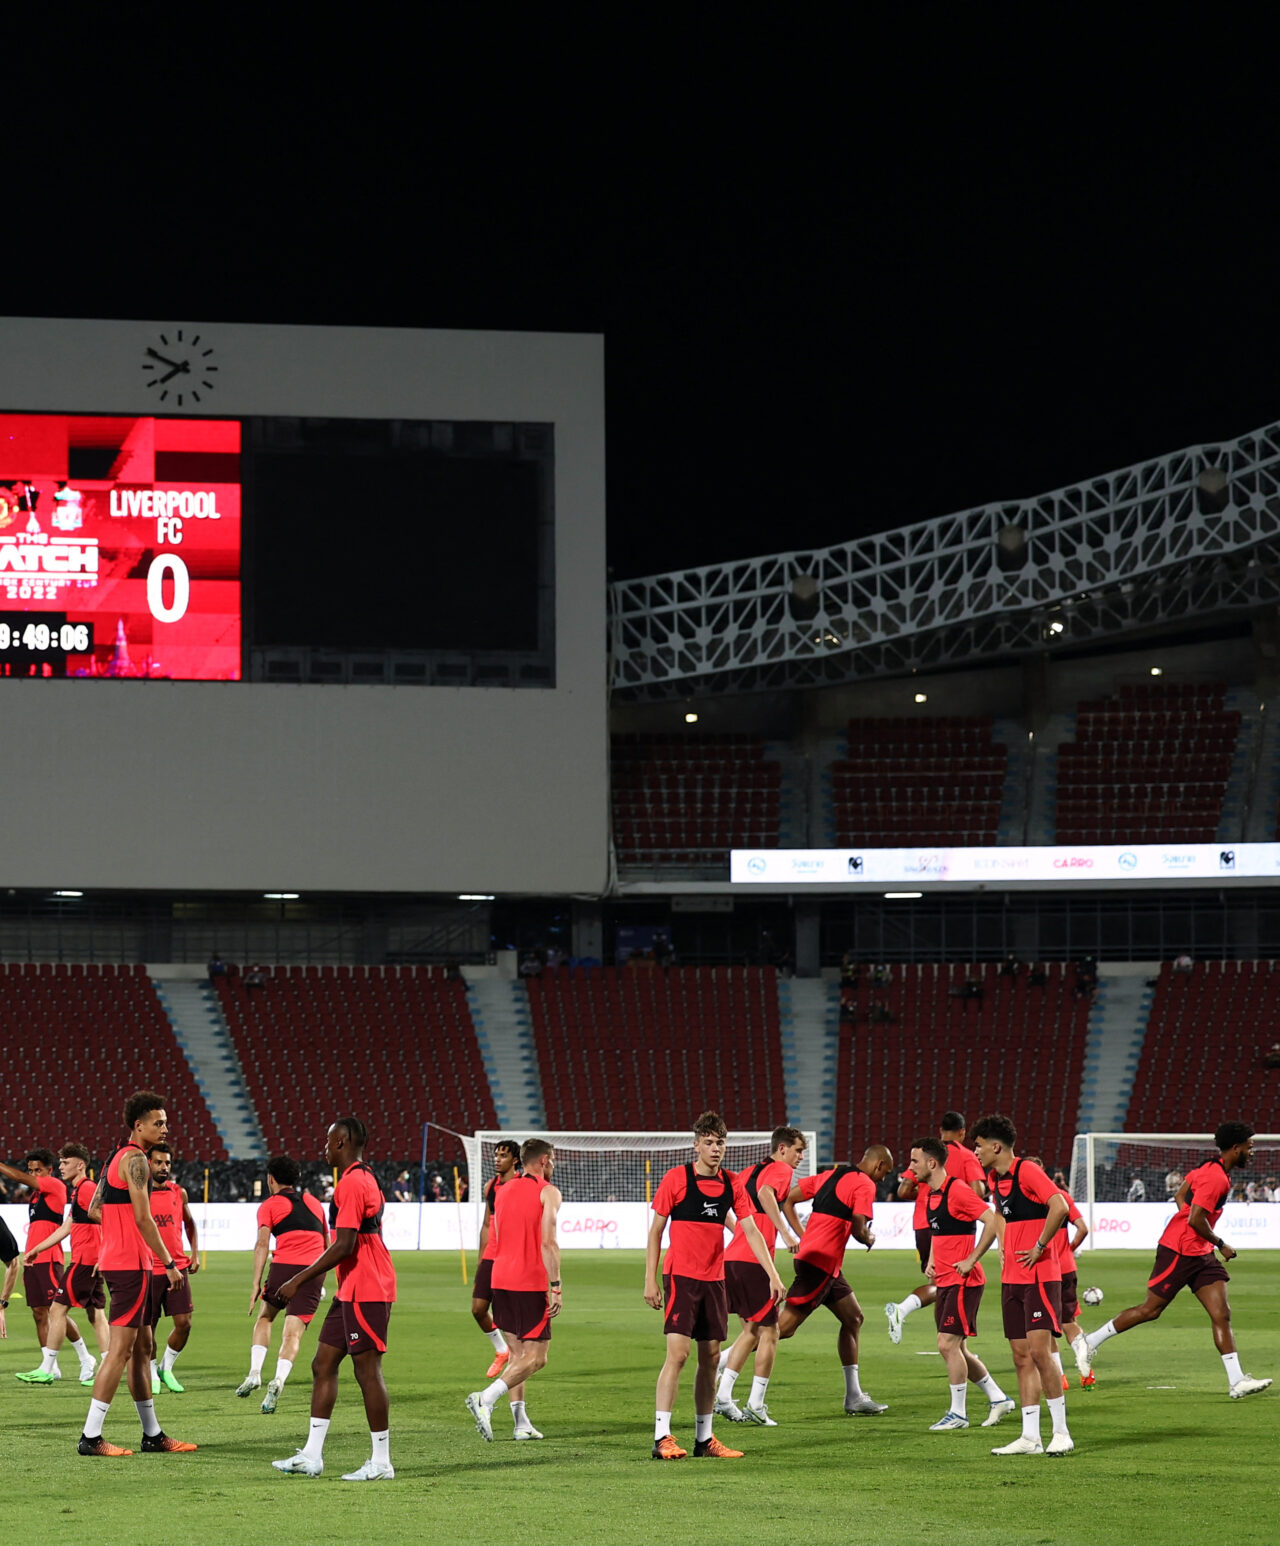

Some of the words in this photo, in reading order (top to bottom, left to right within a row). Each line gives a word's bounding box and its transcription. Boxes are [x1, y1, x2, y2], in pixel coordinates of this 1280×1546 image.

[110, 489, 221, 519] LIVERPOOL
[157, 516, 183, 544] FC
[16, 532, 48, 544] THE
[6, 586, 57, 600] 2022
[147, 553, 190, 623] 0
[1053, 857, 1094, 868] CARRO
[561, 1218, 618, 1233] CARRO
[1088, 1218, 1131, 1233] ARRO
